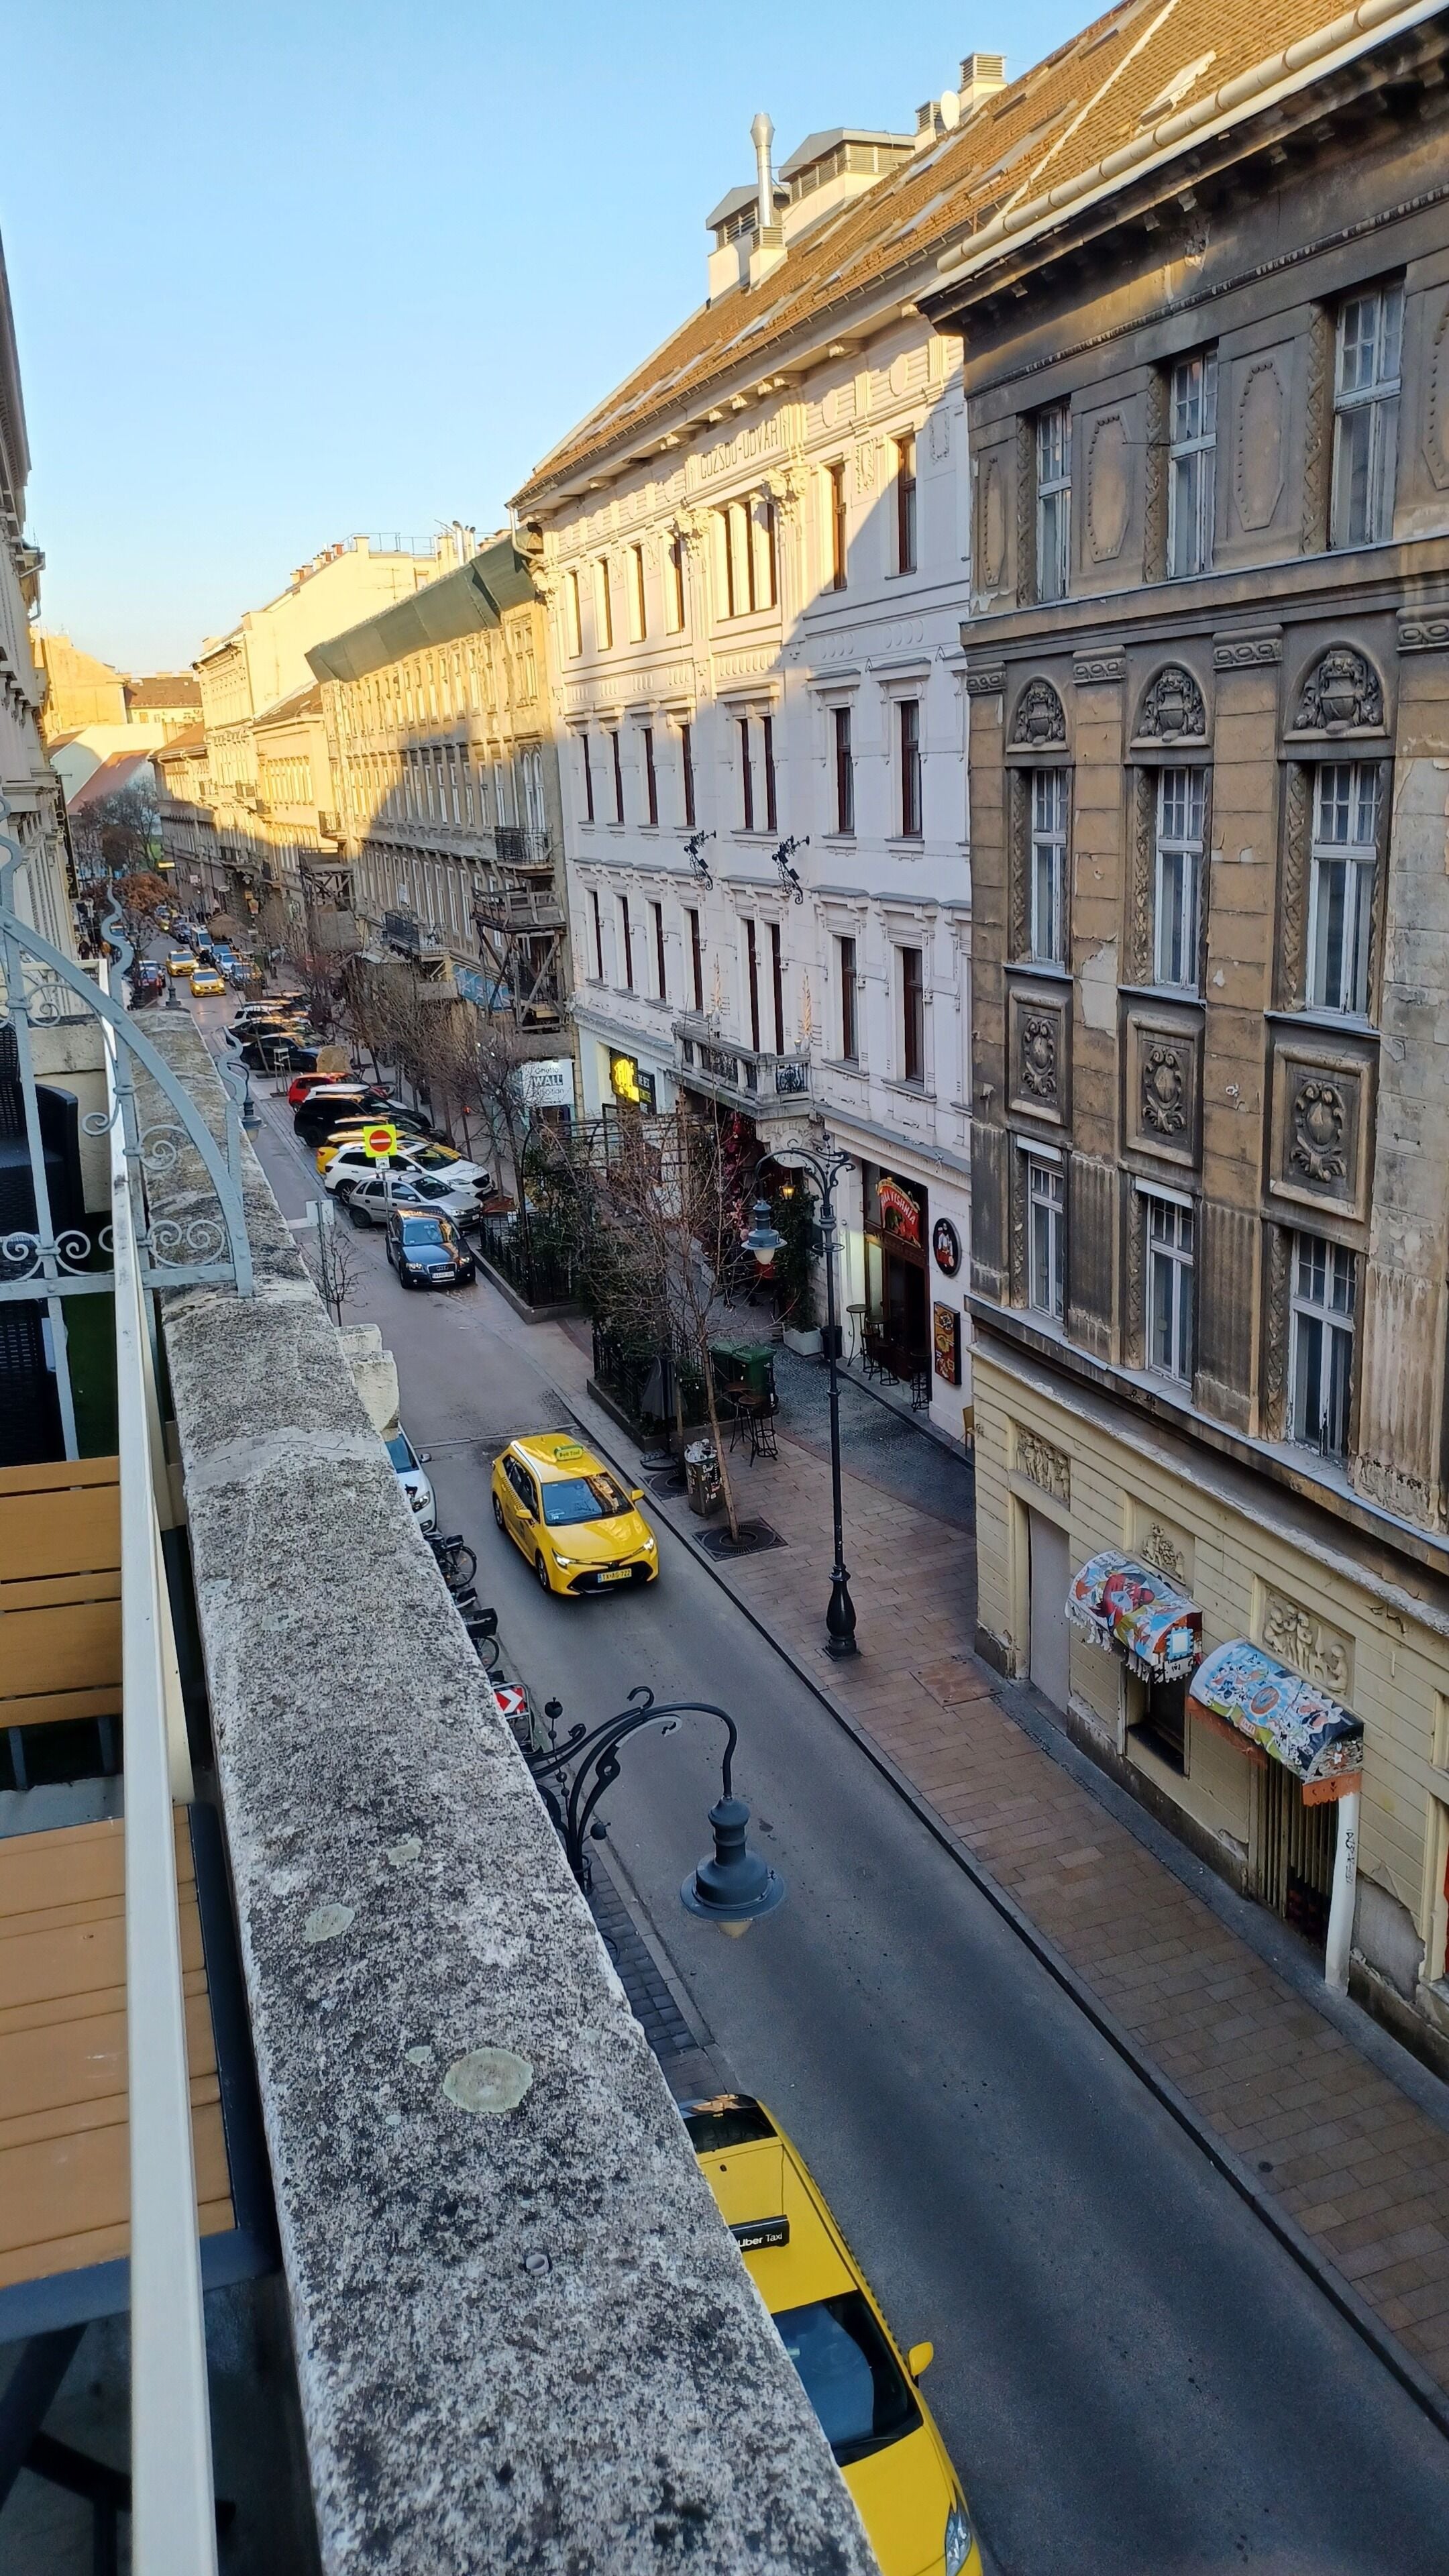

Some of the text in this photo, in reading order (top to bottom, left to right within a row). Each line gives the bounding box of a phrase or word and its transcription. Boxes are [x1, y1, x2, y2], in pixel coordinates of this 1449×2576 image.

[533, 1075, 562, 1086] WALL
[738, 2233, 783, 2247] Uber Taxi
